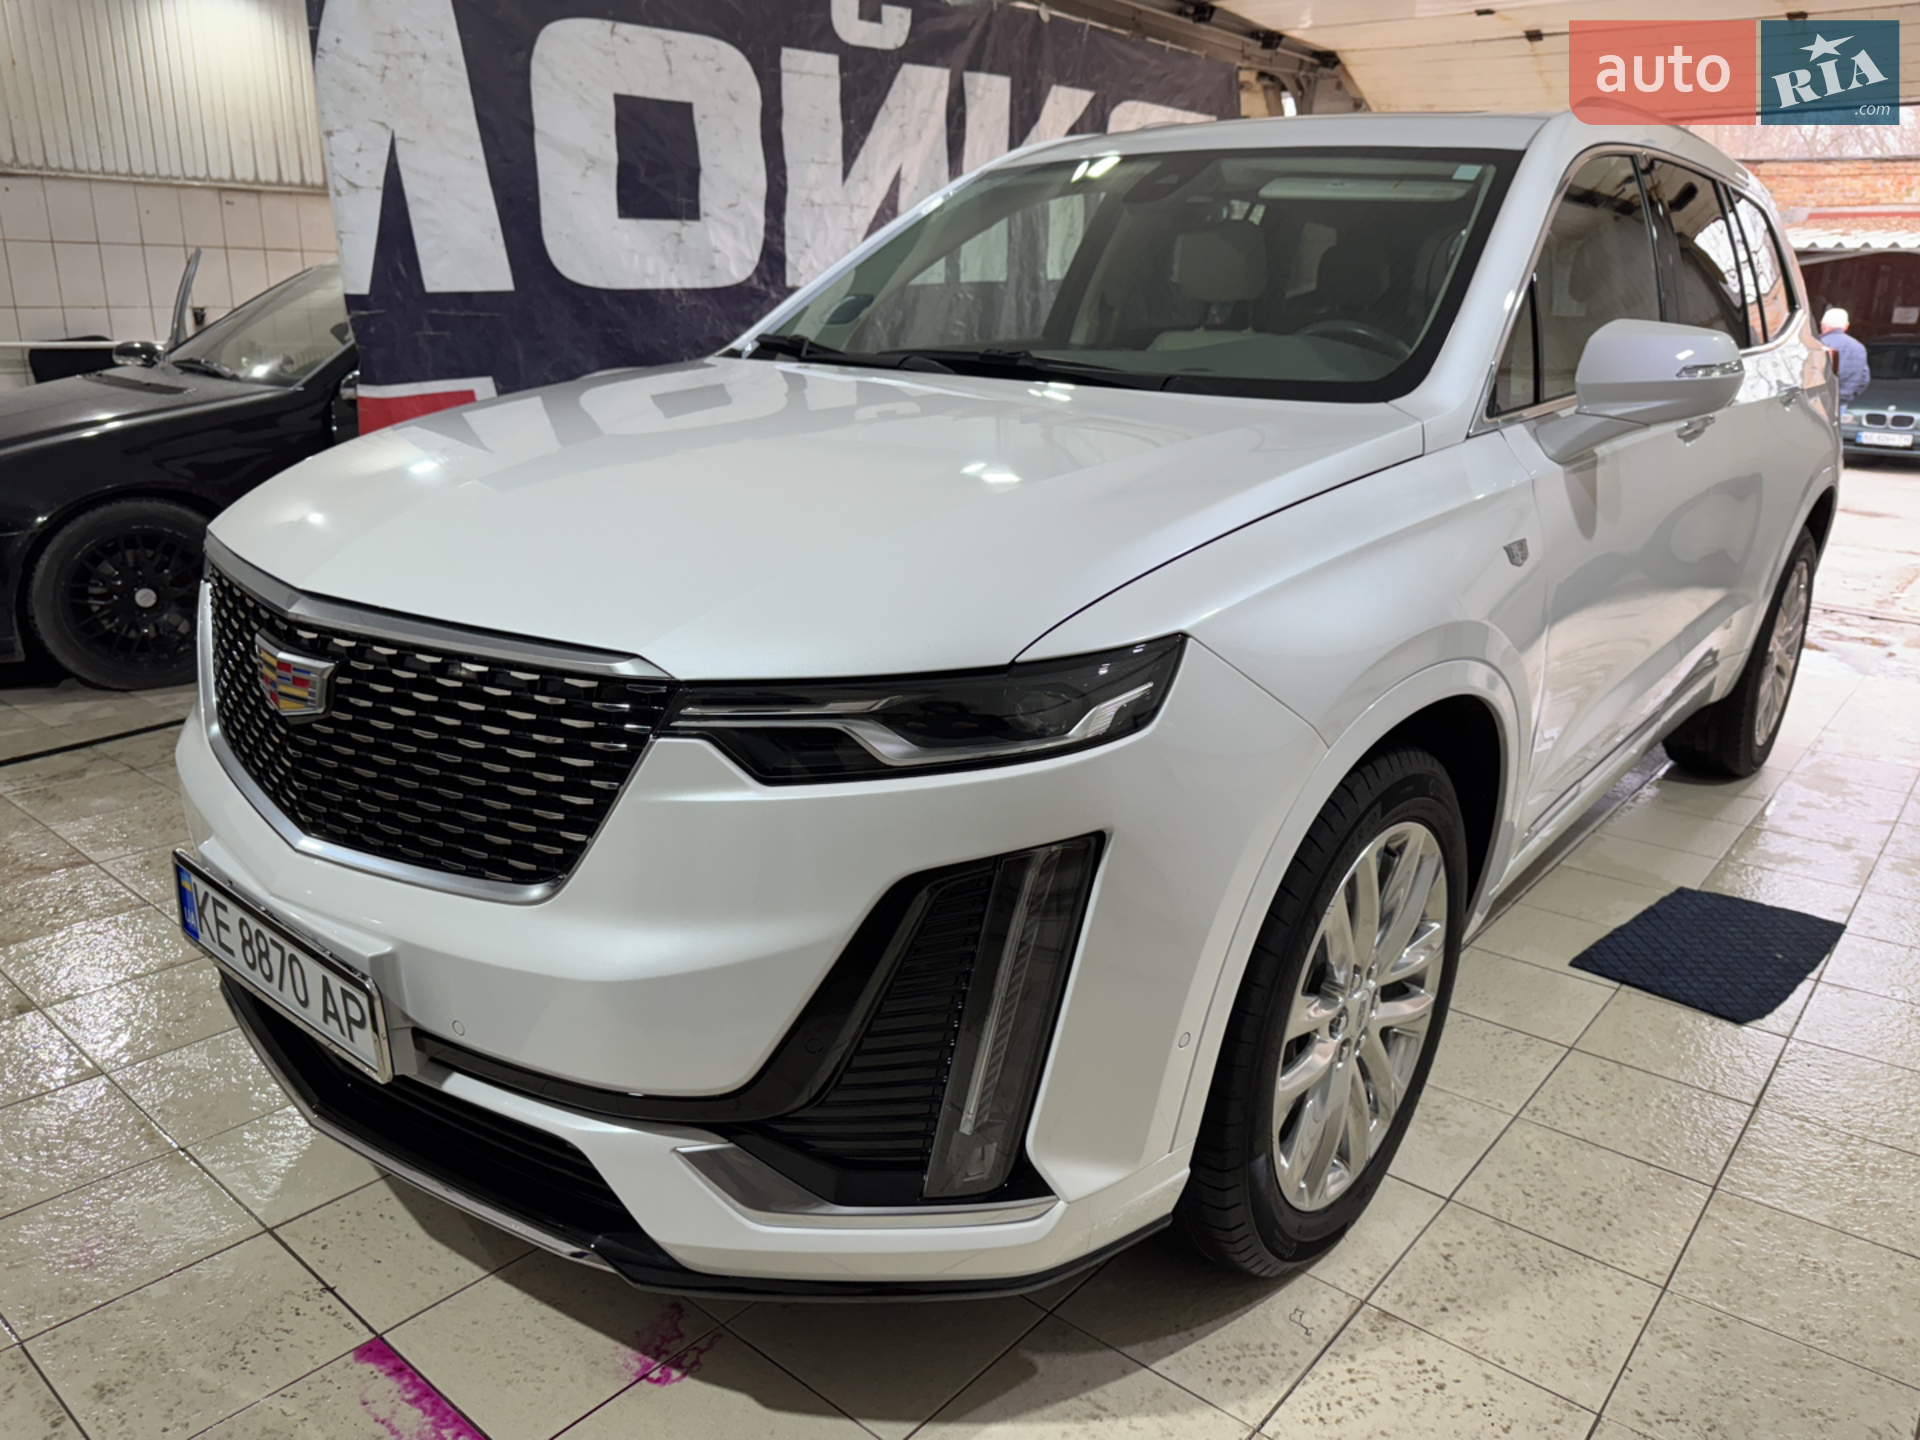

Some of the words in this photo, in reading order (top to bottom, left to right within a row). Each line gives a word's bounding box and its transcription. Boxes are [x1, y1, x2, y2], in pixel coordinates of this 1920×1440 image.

[184, 906, 197, 928] UA
[192, 881, 235, 958] KE
[238, 917, 309, 1009] 8870
[321, 974, 366, 1044] AP
